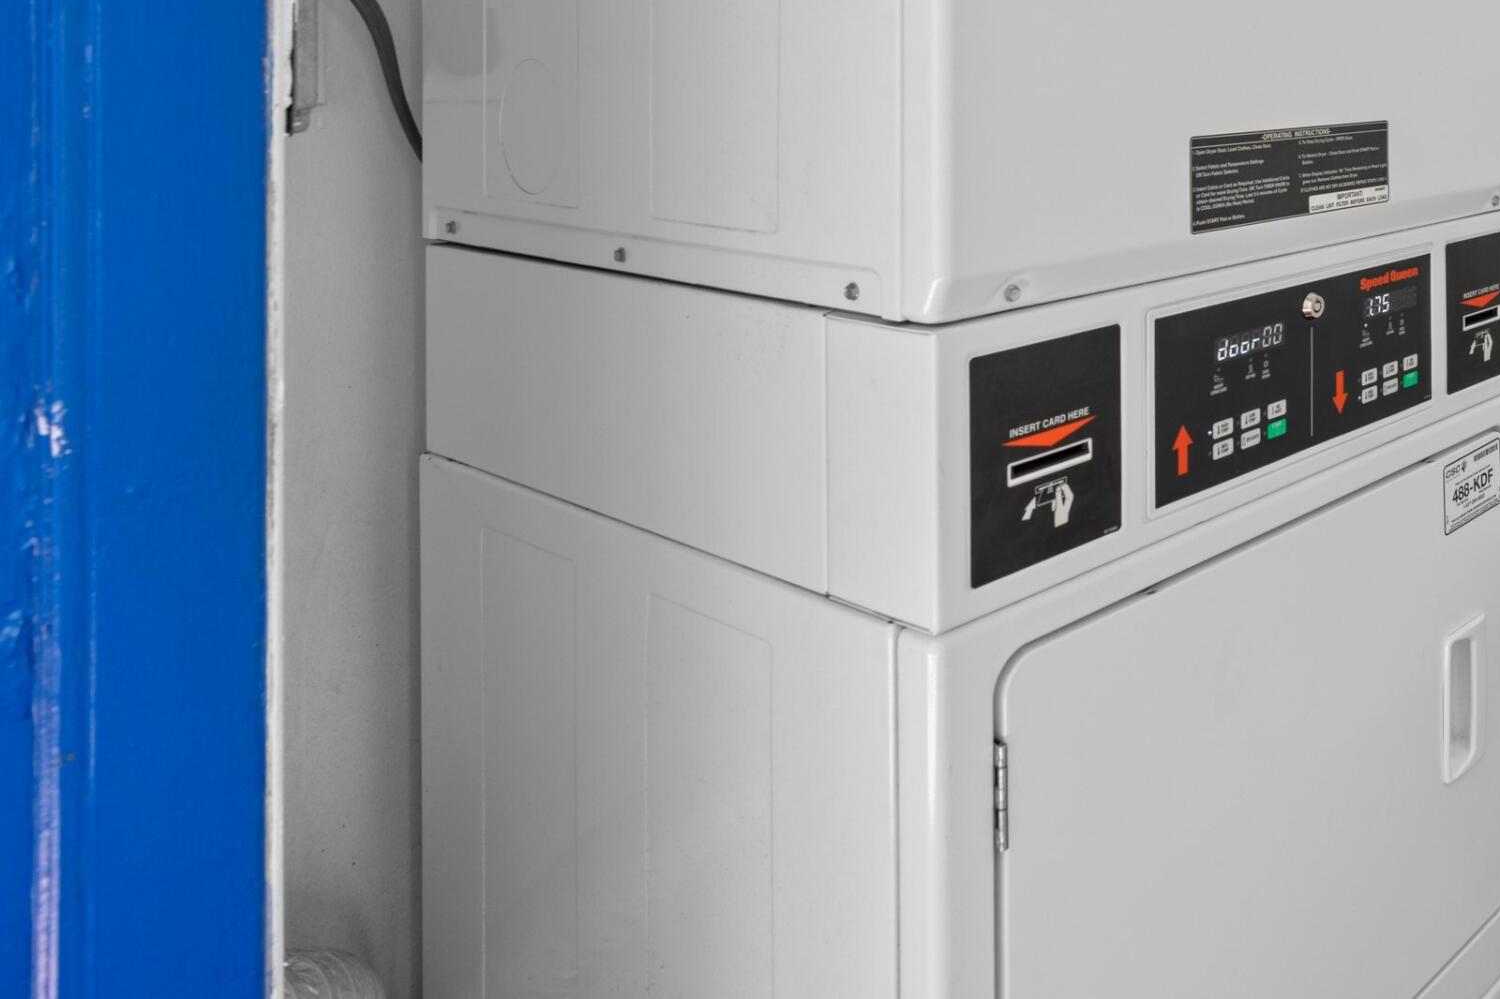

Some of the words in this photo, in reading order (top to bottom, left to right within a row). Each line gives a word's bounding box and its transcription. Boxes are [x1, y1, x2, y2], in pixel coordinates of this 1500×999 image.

[1360, 271, 1389, 291] Speed
[1391, 267, 1418, 281] Queen
[1463, 289, 1478, 299] INSERT
[1478, 286, 1489, 295] CARD
[1489, 283, 1500, 291] HERE
[1009, 421, 1041, 438] INSERT
[1042, 414, 1066, 428] CARD
[1067, 406, 1090, 421] HERE
[1452, 468, 1494, 503] 488-KDF
